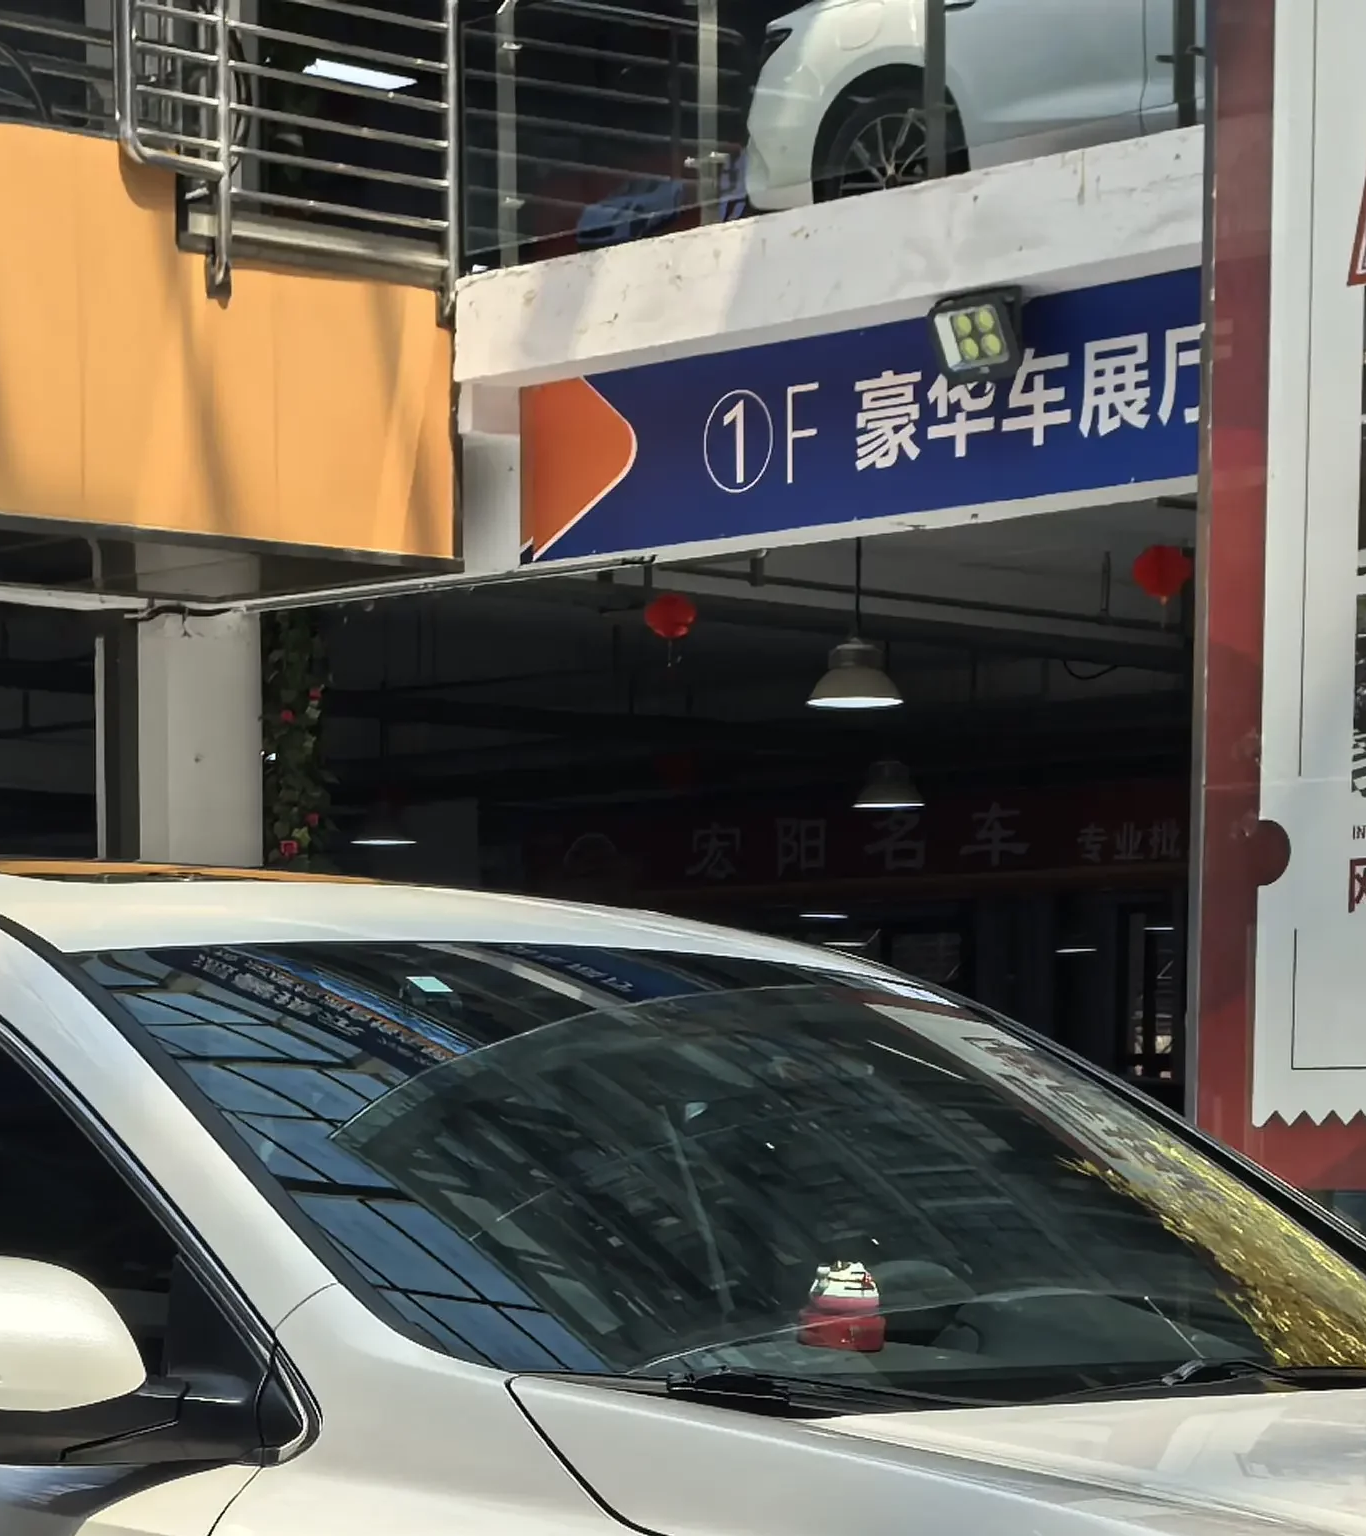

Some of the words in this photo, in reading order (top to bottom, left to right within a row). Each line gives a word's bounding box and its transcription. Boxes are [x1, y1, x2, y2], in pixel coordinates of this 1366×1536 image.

[854, 322, 1207, 472] 豪华车展厅
[685, 801, 1031, 879] 宏阳名车
